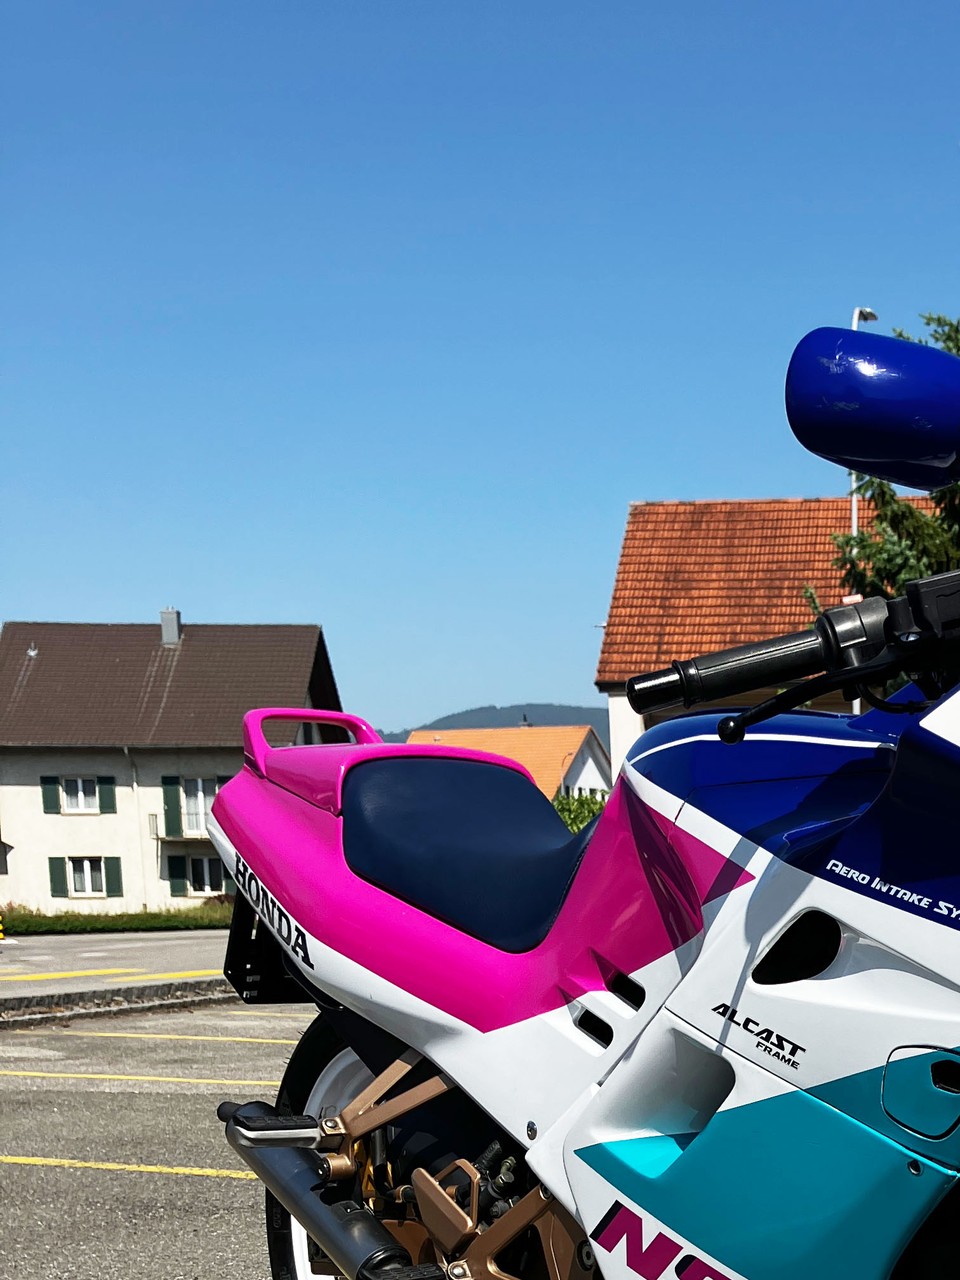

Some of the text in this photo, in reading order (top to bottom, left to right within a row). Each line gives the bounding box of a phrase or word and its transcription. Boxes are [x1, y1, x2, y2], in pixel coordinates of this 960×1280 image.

[825, 858, 871, 885] AERO
[870, 876, 933, 909] INTAKE
[234, 851, 315, 971] HONDA
[711, 1002, 807, 1058] ALCAST
[755, 1040, 801, 1070] FRAME
